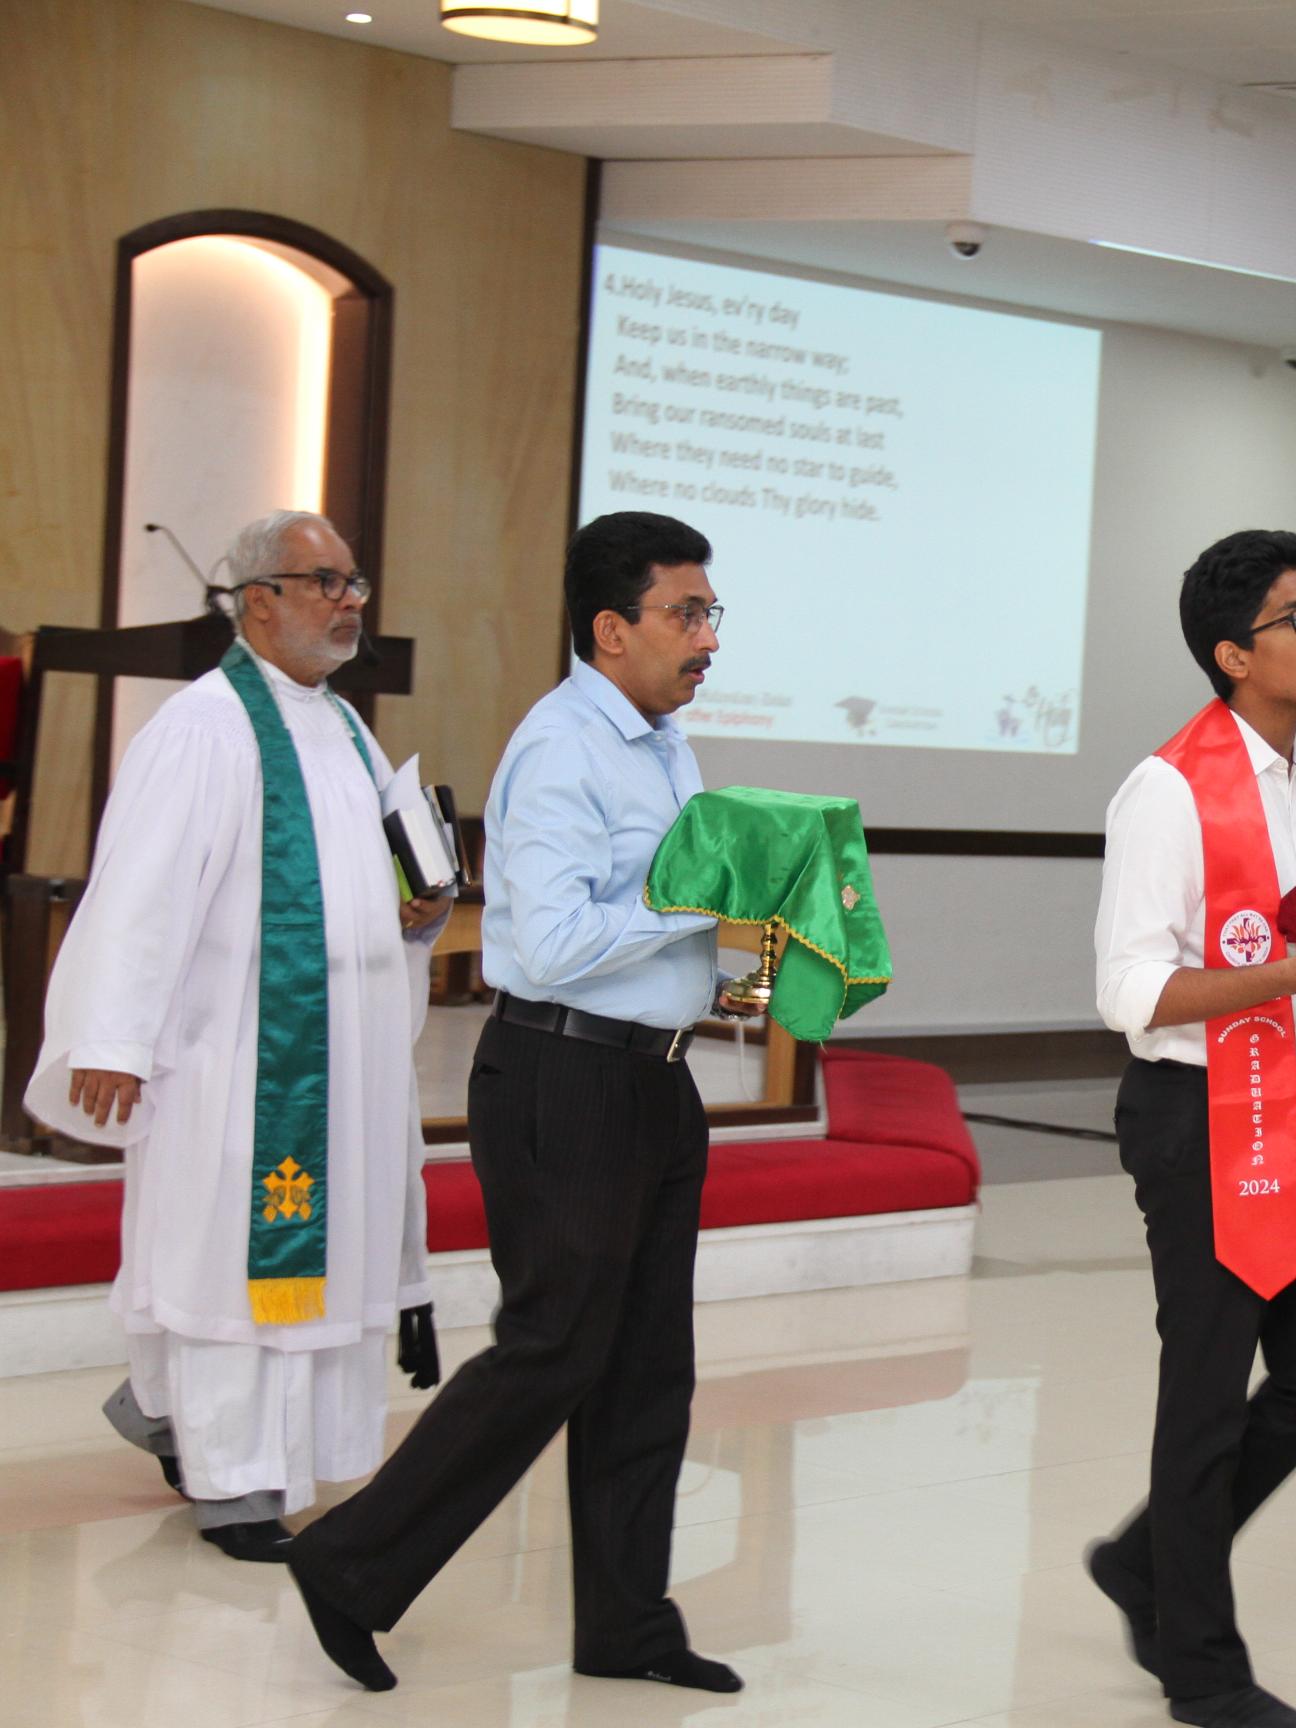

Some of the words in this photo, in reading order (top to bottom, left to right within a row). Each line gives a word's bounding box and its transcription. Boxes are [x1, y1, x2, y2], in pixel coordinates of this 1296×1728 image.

[666, 283, 719, 316] Jesus,
[769, 301, 801, 331] day
[617, 313, 662, 347] Keep
[667, 328, 687, 347] us
[691, 325, 709, 349] in
[712, 328, 741, 355] the
[746, 340, 806, 364] narrow
[613, 354, 657, 383] And,
[661, 360, 711, 388] when
[715, 372, 776, 402] earthly
[781, 377, 832, 410] things
[835, 391, 861, 411] are
[612, 391, 660, 425] Bring
[664, 404, 696, 424] our
[699, 410, 784, 437] ransomed
[789, 420, 832, 443] souls
[834, 427, 851, 446] at
[609, 431, 672, 460] Where
[676, 439, 715, 470] they
[719, 449, 762, 471] need
[766, 457, 788, 474] no
[792, 458, 824, 478] star
[827, 460, 845, 481] to
[607, 469, 669, 497] Where
[673, 482, 696, 501] no
[701, 481, 757, 507] clouds
[761, 486, 790, 516] Thy
[795, 494, 836, 521] glory
[1218, 1016, 1251, 1044] SUNDAY
[1254, 1016, 1286, 1039] SCHOOL
[1249, 1033, 1265, 1166] GRADUATION
[1238, 1179, 1281, 1197] 2024
